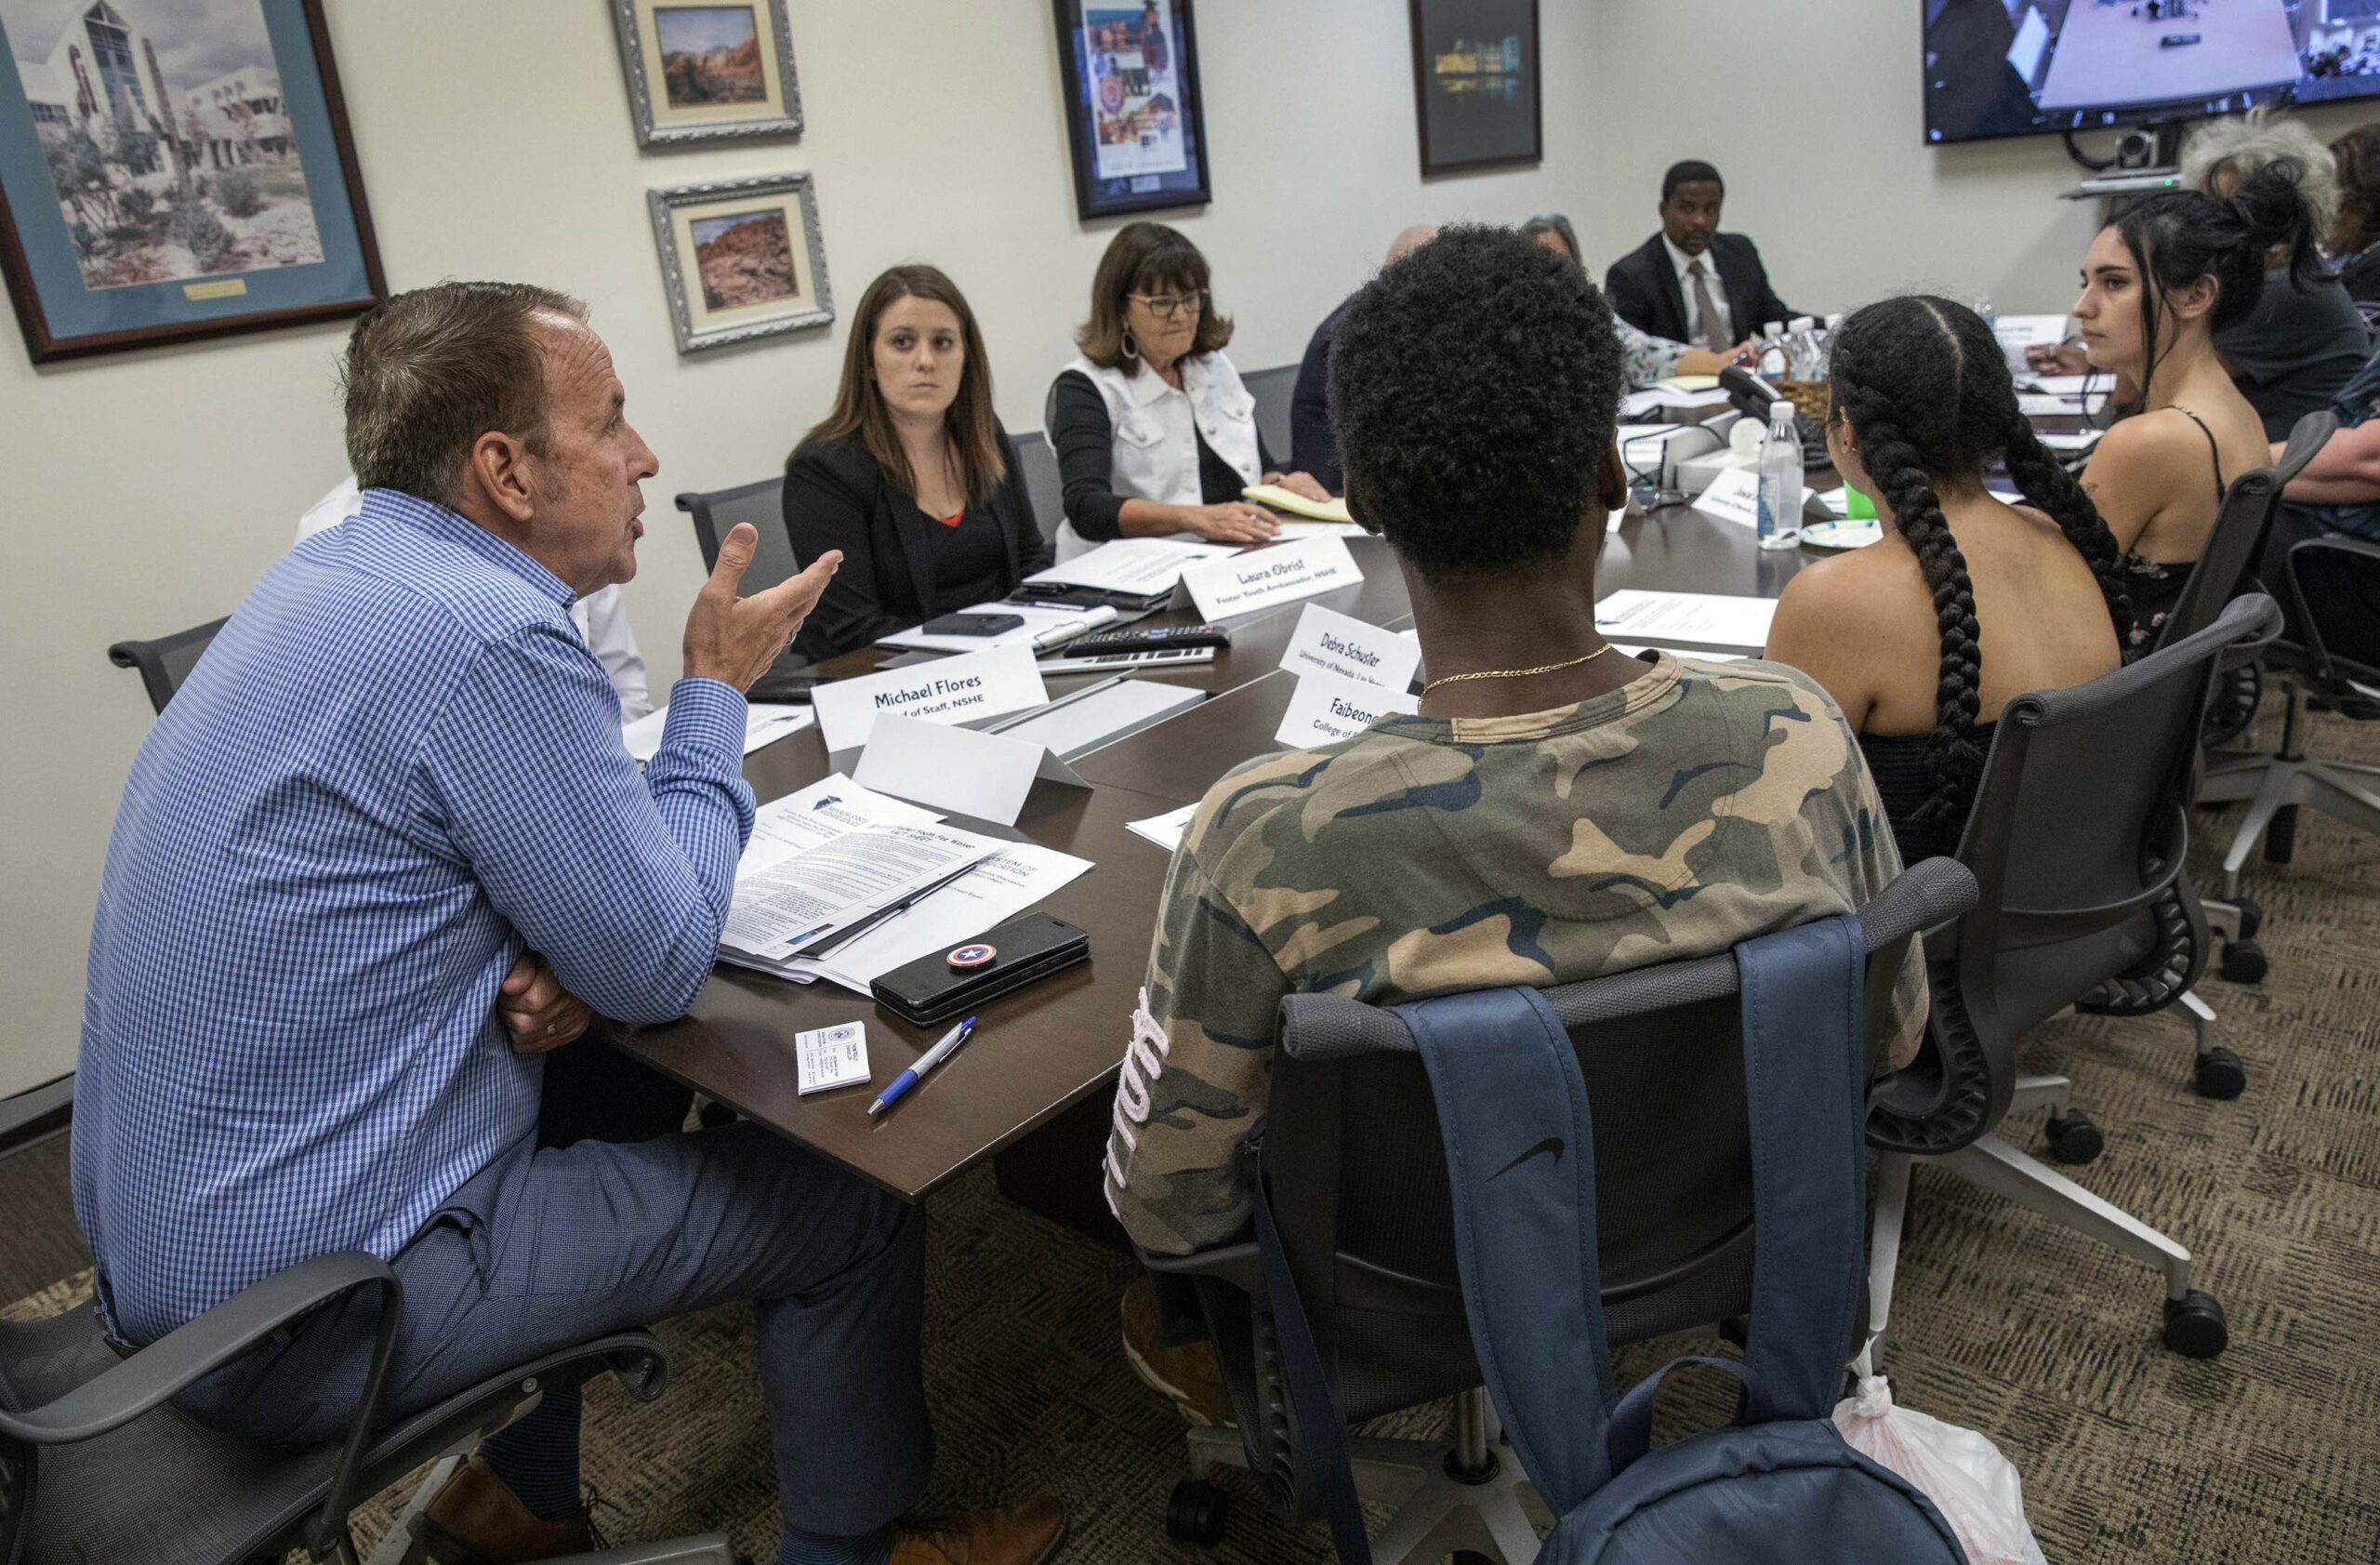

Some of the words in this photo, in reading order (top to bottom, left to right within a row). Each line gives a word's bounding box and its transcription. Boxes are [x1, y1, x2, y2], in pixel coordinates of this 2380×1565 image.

[1236, 569, 1272, 585] Laura
[1272, 558, 1306, 577] Obrist
[1216, 593, 1241, 604] Foster
[1242, 588, 1265, 598] Youth
[1298, 648, 1327, 670] University
[1326, 661, 1335, 670] of
[1320, 632, 1345, 655] Debra
[1345, 642, 1381, 669] Schuster
[875, 683, 932, 709] Michael
[935, 675, 982, 696] Flores
[910, 708, 921, 719] of
[923, 702, 951, 715] Staff,
[953, 694, 985, 709] NSHE
[1313, 719, 1342, 739] College
[1342, 730, 1352, 739] of
